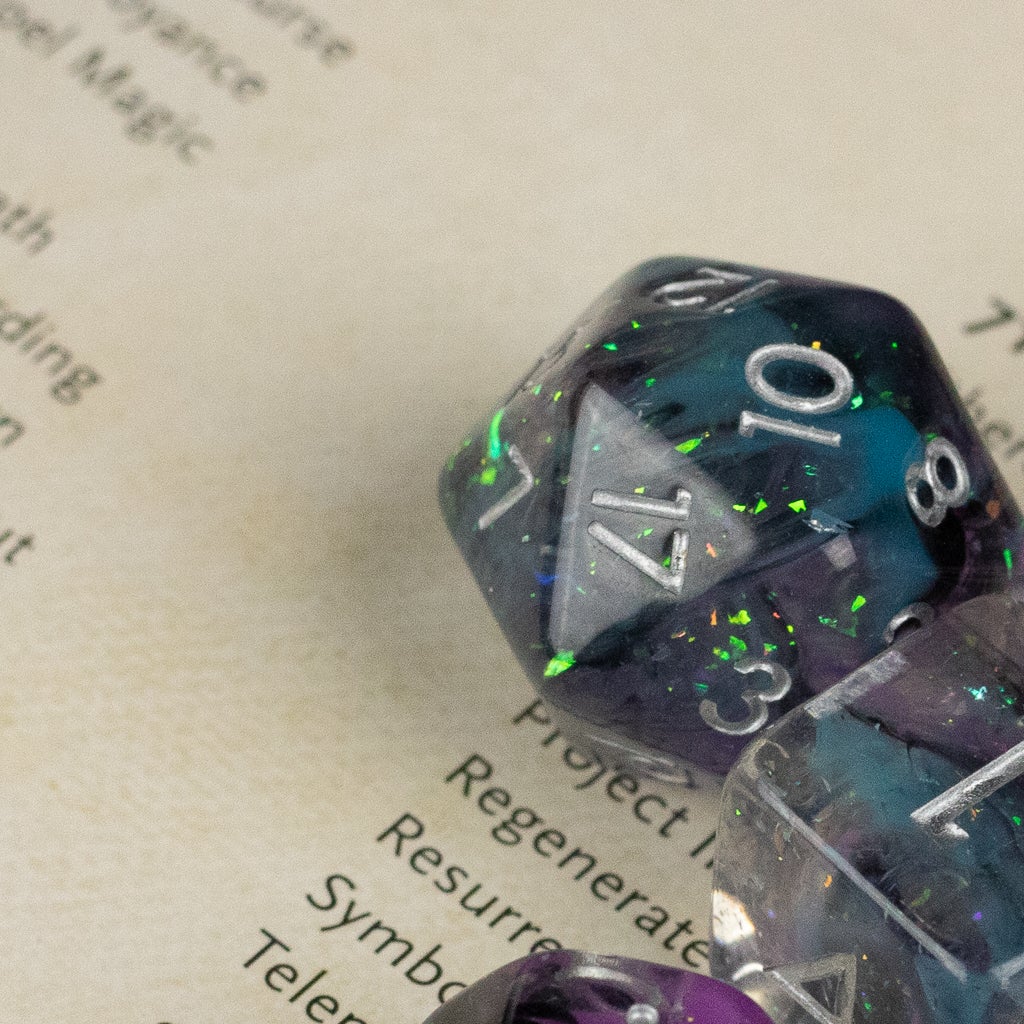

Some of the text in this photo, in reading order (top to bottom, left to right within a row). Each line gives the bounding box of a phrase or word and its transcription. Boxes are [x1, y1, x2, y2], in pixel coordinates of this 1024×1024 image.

[68, 46, 216, 166] Magic
[738, 342, 856, 449] 10
[906, 436, 971, 528] 8
[699, 658, 793, 737] 3
[510, 699, 690, 838] Project
[443, 752, 711, 969] Regenerate
